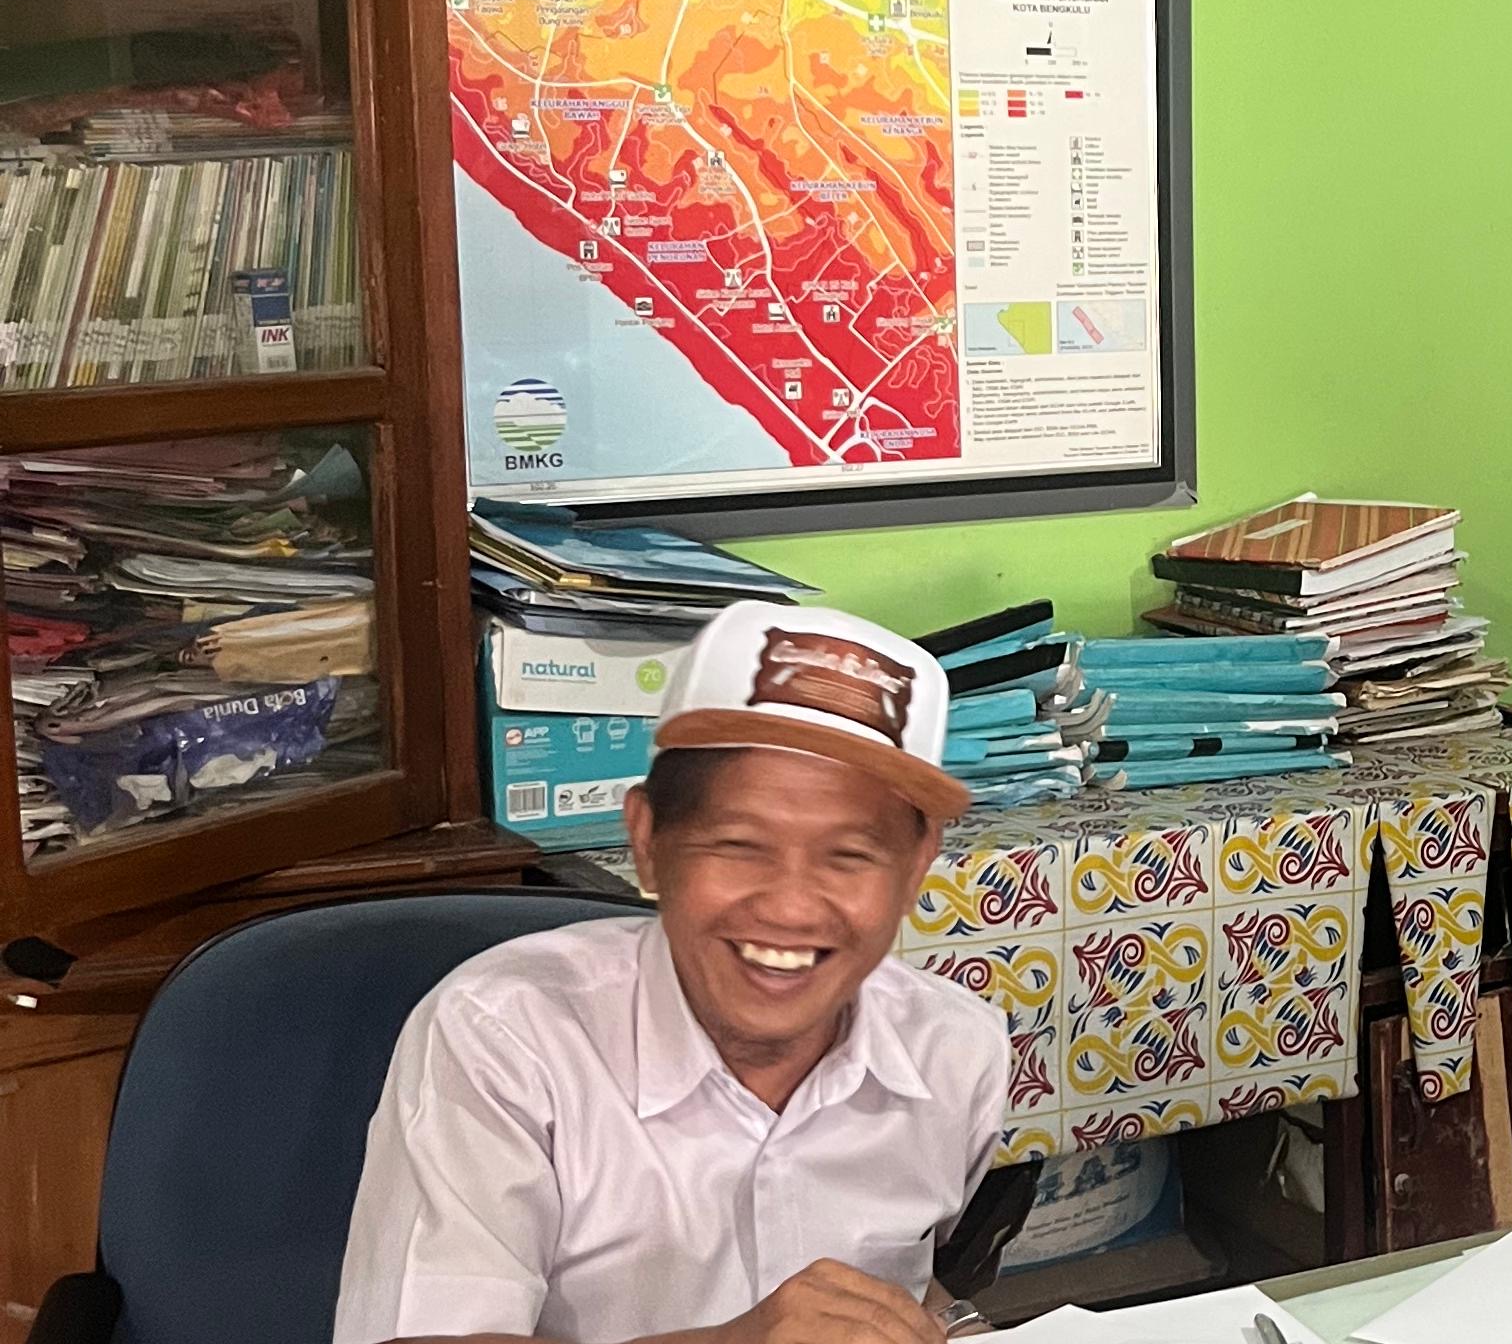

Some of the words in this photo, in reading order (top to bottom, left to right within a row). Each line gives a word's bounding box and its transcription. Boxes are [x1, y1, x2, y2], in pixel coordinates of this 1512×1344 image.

[1012, 4, 1038, 13] KOTA
[1040, 4, 1091, 14] BENGKULU
[262, 327, 290, 343] INK
[505, 453, 564, 470] BMKG
[522, 659, 597, 678] natural
[524, 726, 550, 739] APP
